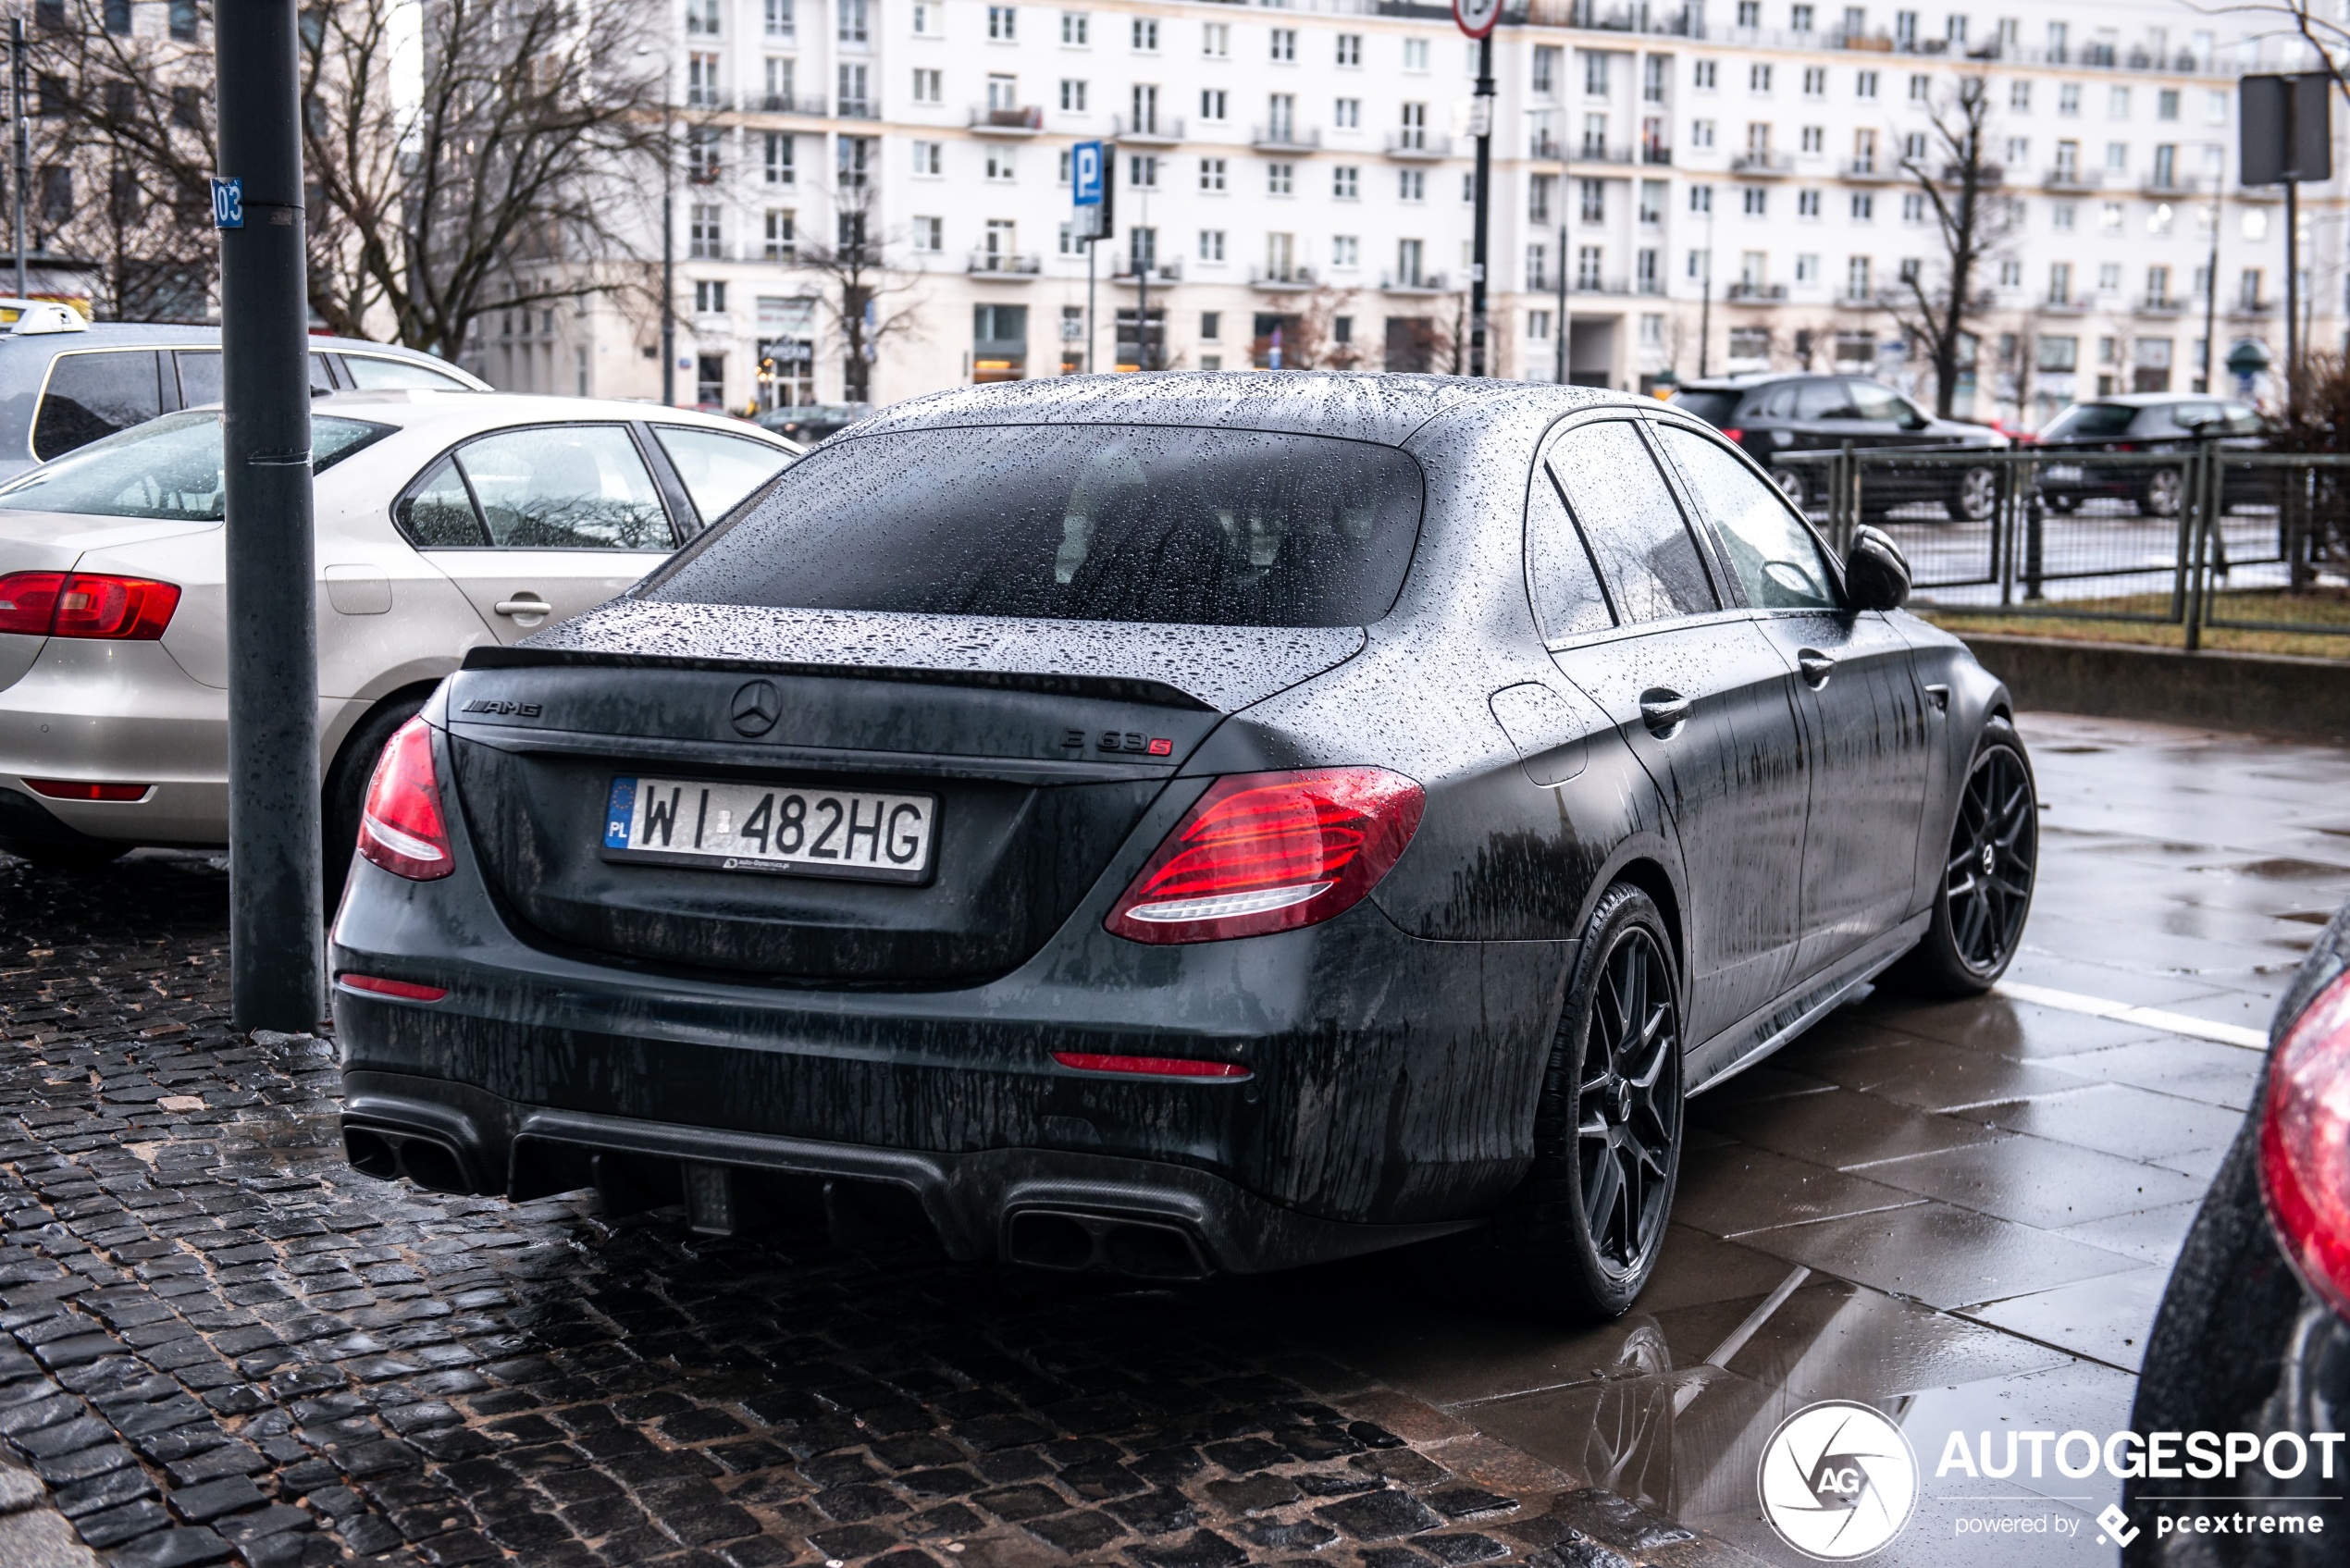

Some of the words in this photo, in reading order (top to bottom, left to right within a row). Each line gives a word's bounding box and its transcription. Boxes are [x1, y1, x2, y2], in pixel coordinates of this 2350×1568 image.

[1077, 148, 1098, 198] P
[481, 700, 543, 718] AMG
[608, 821, 628, 839] PL
[740, 793, 922, 864] 482HG
